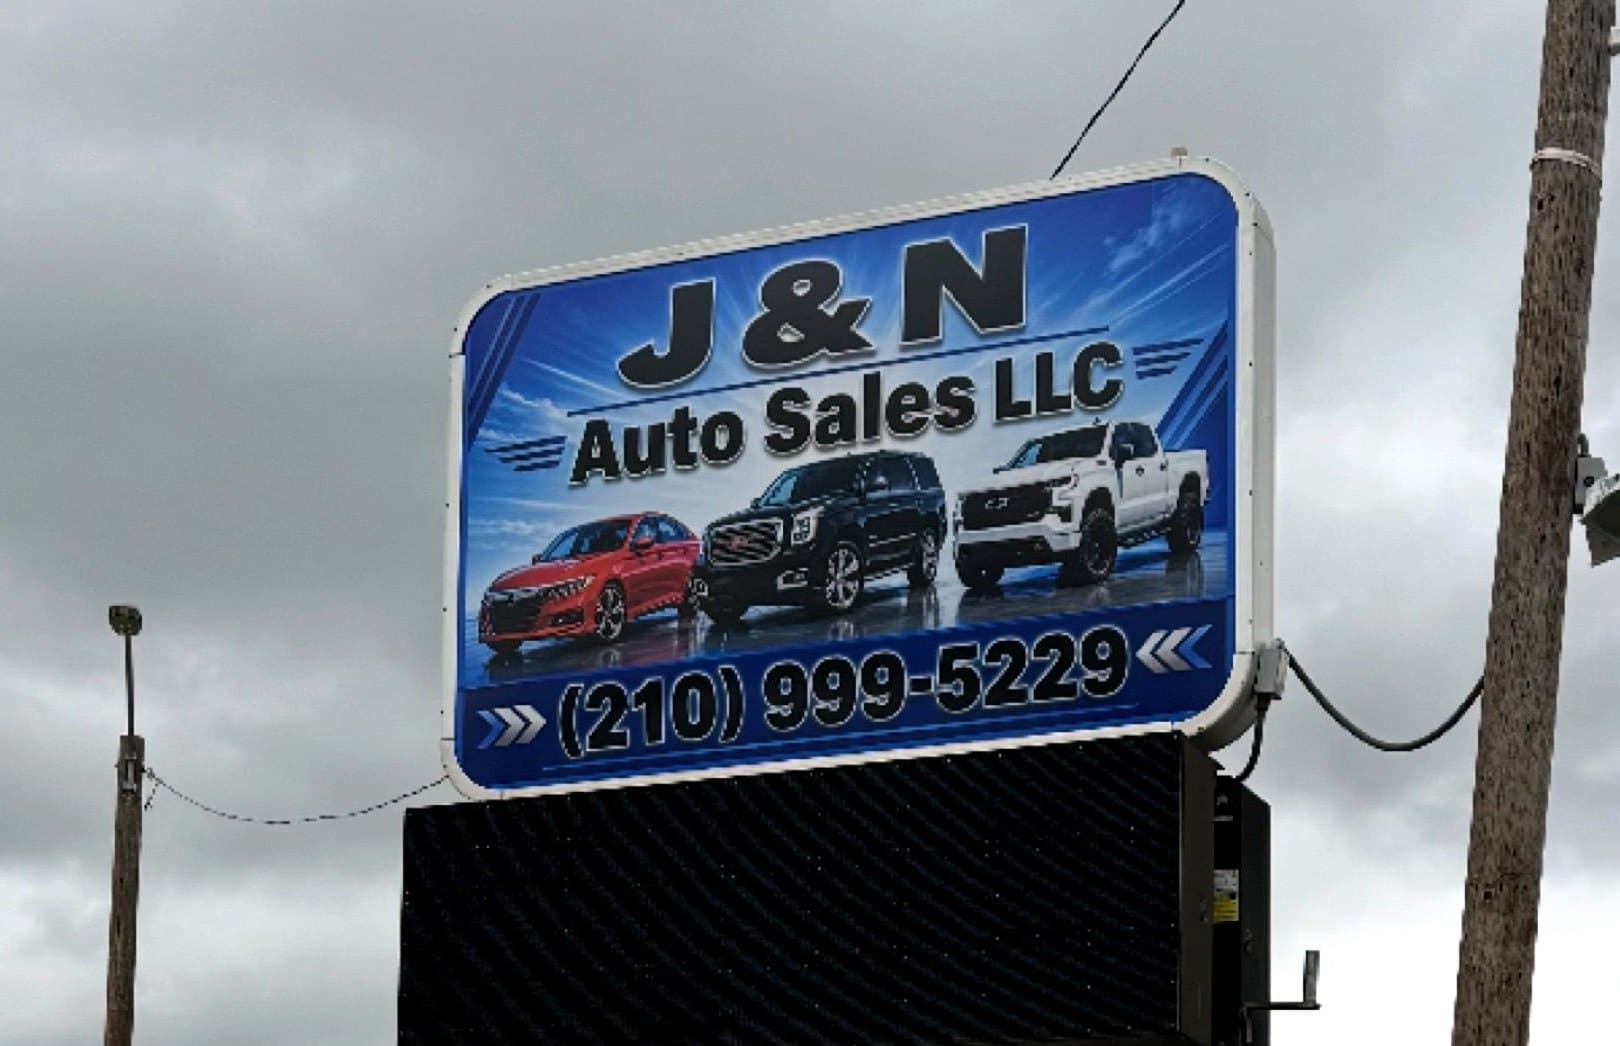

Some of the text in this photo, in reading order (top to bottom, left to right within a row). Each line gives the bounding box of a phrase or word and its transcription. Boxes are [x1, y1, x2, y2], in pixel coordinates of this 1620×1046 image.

[617, 223, 1028, 388] J & N
[569, 340, 1124, 487] Auto Sales LLC
[558, 627, 1129, 759] (210) 999-5229
